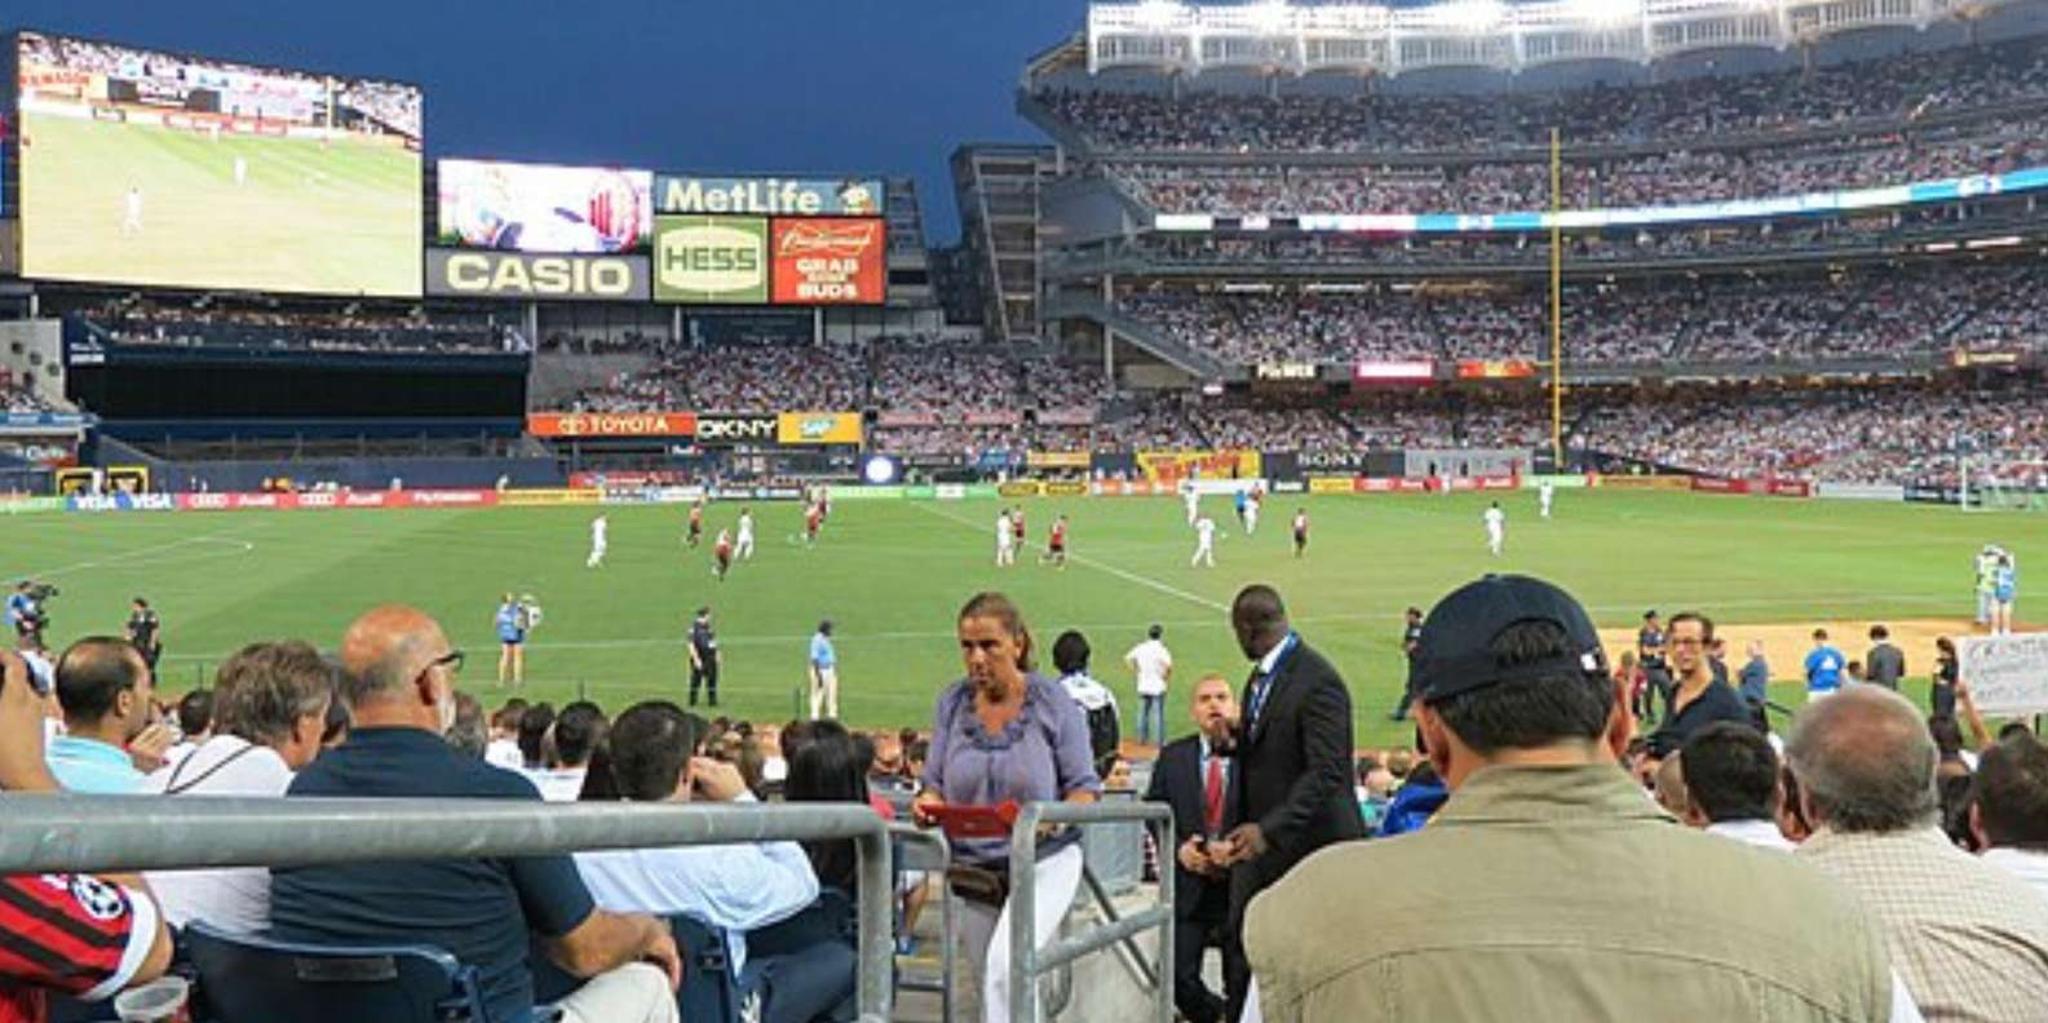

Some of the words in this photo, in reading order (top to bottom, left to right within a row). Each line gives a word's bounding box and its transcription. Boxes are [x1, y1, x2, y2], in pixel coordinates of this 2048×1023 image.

[665, 178, 822, 215] MetLife
[665, 246, 758, 271] HESS
[446, 253, 632, 295] CASIO
[589, 415, 669, 433] TOYOTA
[697, 418, 777, 439] DKNY
[133, 493, 173, 509] VISA
